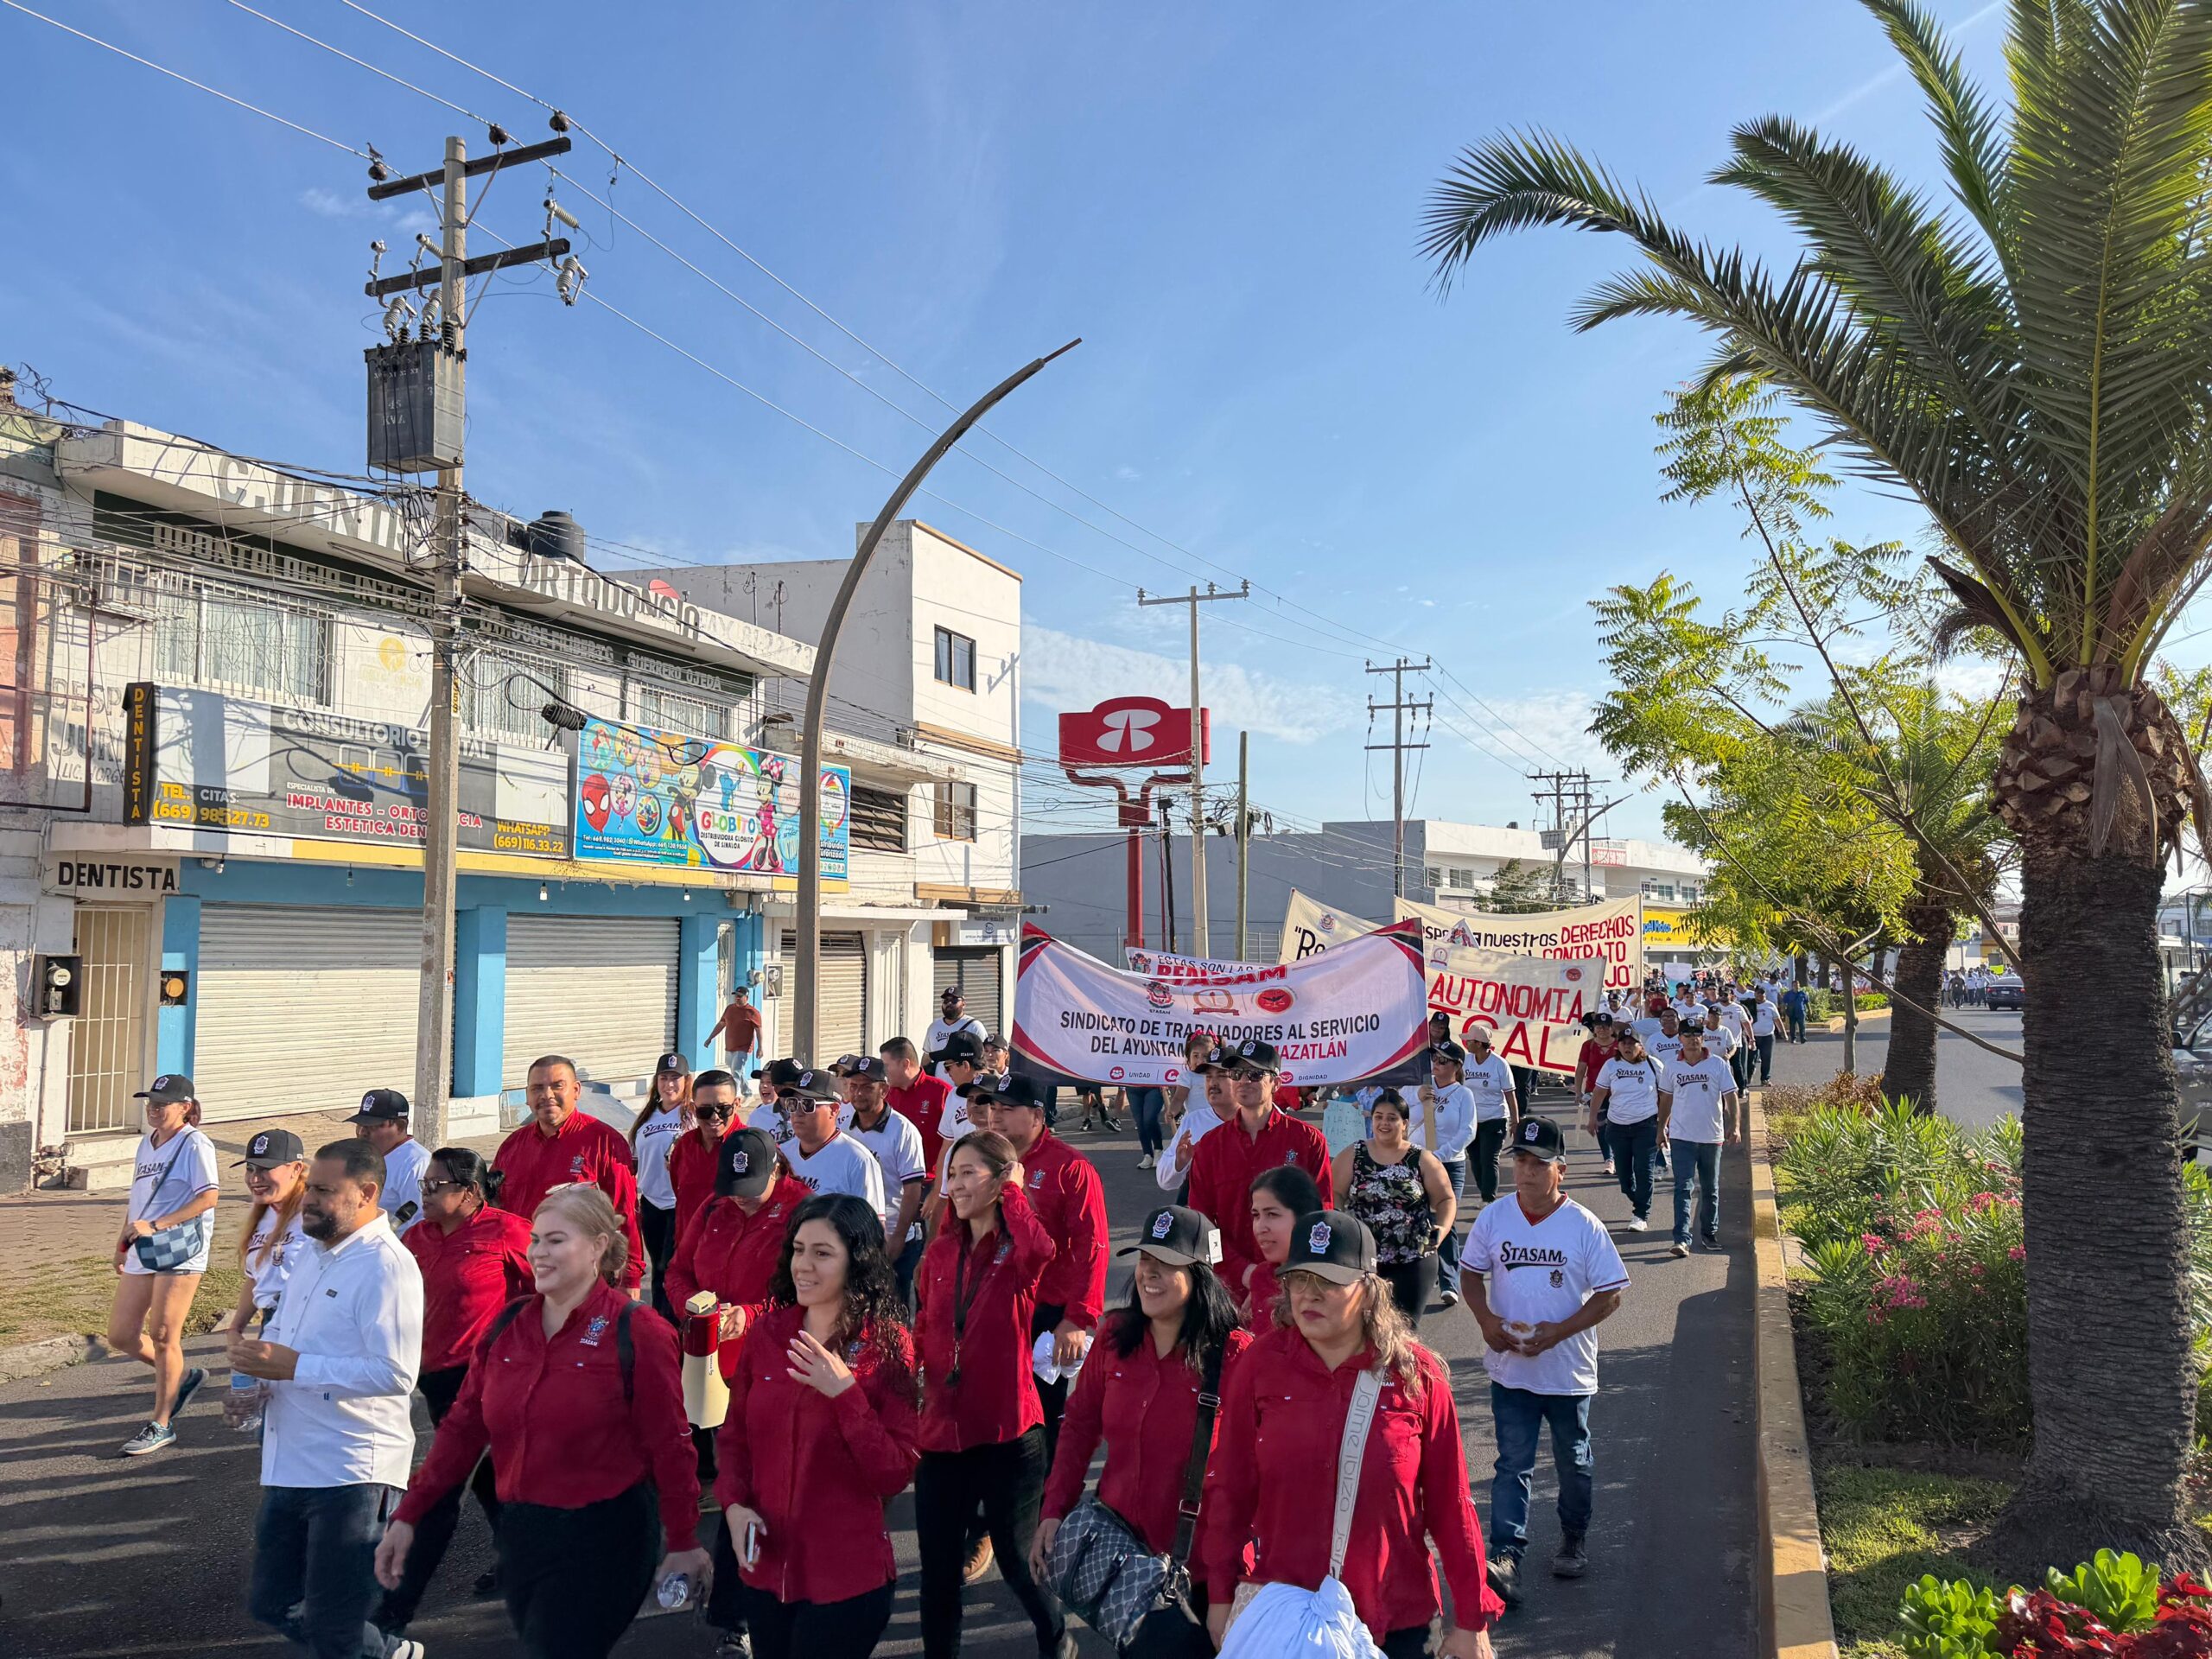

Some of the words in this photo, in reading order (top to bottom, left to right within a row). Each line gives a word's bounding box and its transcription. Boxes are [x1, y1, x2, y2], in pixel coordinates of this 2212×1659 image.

[627, 651, 682, 681] GUERRERO
[687, 668, 722, 691] OJEDA
[52, 678, 124, 718] DESP
[283, 709, 421, 748] CONSULTORIO
[131, 688, 144, 818] DENTISTA
[62, 763, 83, 780] LIC.
[161, 783, 191, 800] TEL.
[200, 789, 239, 804] CITAS:
[287, 782, 326, 793] ESPECIALISTA
[153, 799, 197, 823] (669)
[286, 792, 372, 816] IMPLANTES
[325, 814, 395, 836] ESTETICA
[497, 821, 550, 836] WHATSAPP
[701, 810, 756, 835] GLOBITO
[493, 833, 522, 850] (669)
[523, 837, 564, 854] 116.33.22
[700, 831, 734, 842] DISTRIBUIDORA
[734, 835, 754, 843] GLOBITO
[820, 839, 845, 850] stribuidor
[820, 849, 845, 860] utorizado
[1484, 931, 1557, 948] nuestros
[1560, 914, 1635, 944] DERECHOS
[1157, 955, 1196, 969] ESTAS
[1199, 962, 1226, 974] SON
[1427, 972, 1583, 1026] AUTONOMIA
[1059, 1010, 1135, 1034] SINDICATO
[1140, 1018, 1160, 1035] DE
[1287, 1021, 1306, 1039] AL
[1310, 1013, 1381, 1038] SERVICIO
[1091, 1035, 1119, 1055] DEL
[1656, 1042, 1681, 1052] STASAM
[1298, 1073, 1328, 1082] DIGNIDAD
[1465, 1069, 1491, 1079] STASAM
[1616, 1068, 1645, 1078] STASAM
[1676, 1073, 1709, 1084] STASAM
[642, 1122, 683, 1135] STASAM
[1500, 1241, 1567, 1265] STASAM
